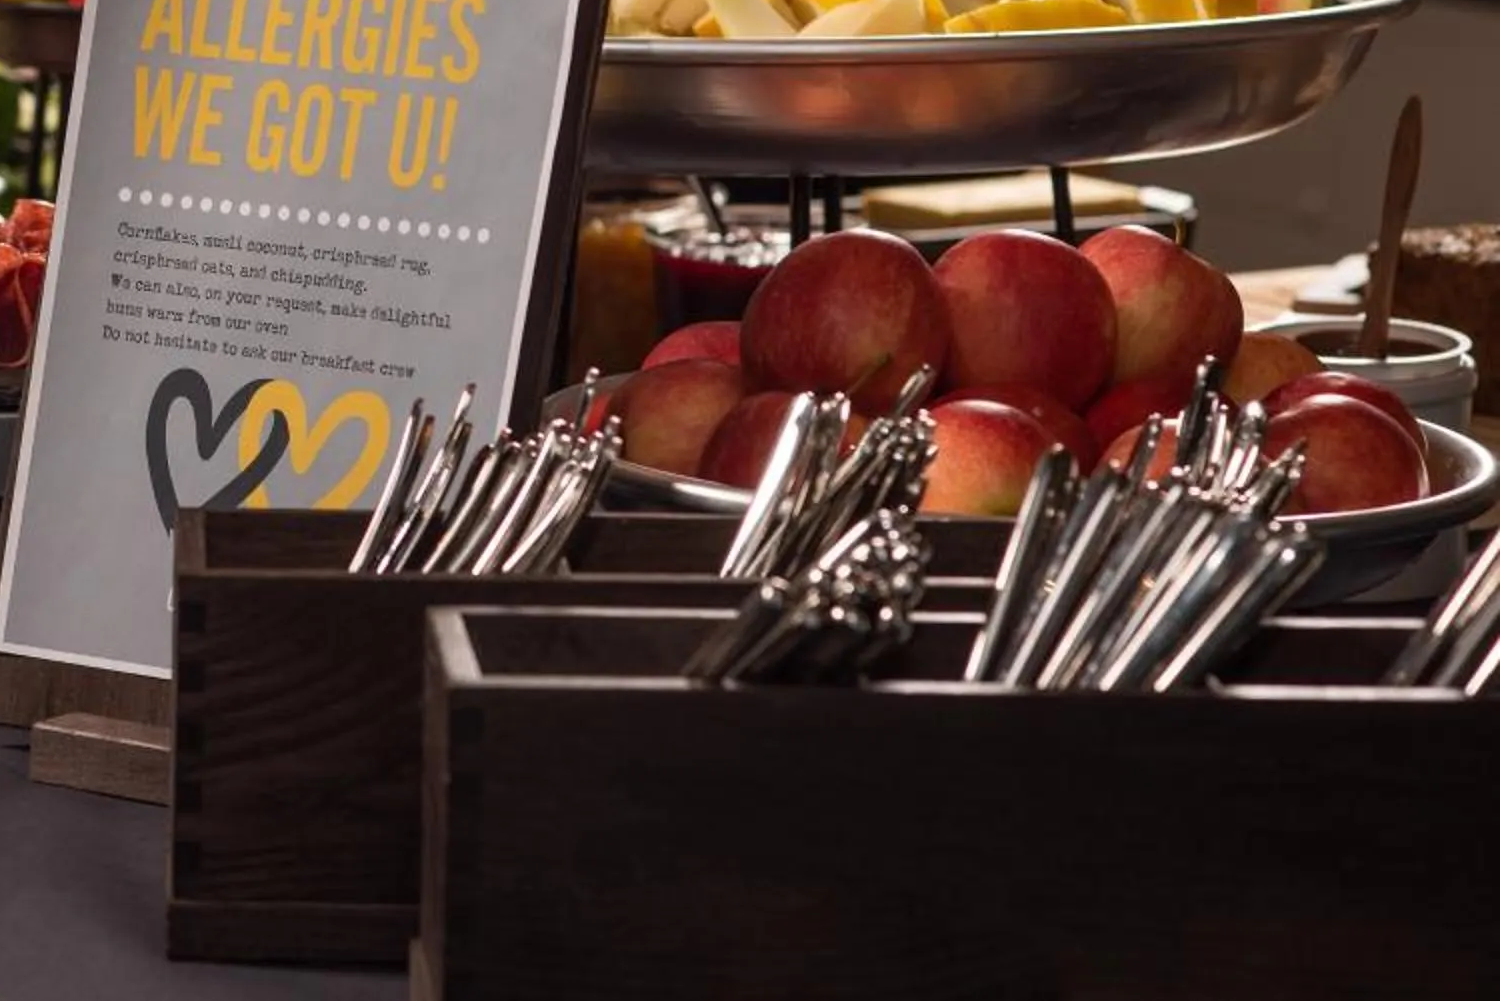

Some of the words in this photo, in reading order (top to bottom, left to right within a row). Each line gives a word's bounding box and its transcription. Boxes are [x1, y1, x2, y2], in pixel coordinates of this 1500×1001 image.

[134, 65, 234, 167] WE
[245, 79, 379, 183] GOT
[388, 94, 459, 191] U!
[239, 264, 267, 280] and
[106, 298, 144, 319] buns
[147, 308, 184, 323] warm
[187, 308, 221, 327] from
[225, 316, 251, 331] our
[255, 321, 289, 336] oven
[111, 273, 132, 289] We
[135, 279, 162, 294] can
[205, 288, 223, 301] on
[225, 291, 262, 307] your
[330, 302, 367, 319] make
[370, 305, 452, 330] delightful
[102, 324, 121, 342] Do
[125, 330, 150, 345] not
[153, 332, 218, 354] hesitate
[222, 341, 238, 356] to
[241, 344, 267, 360] ask
[270, 349, 297, 363] our
[301, 350, 375, 374] breakfast
[379, 363, 416, 379] crew
